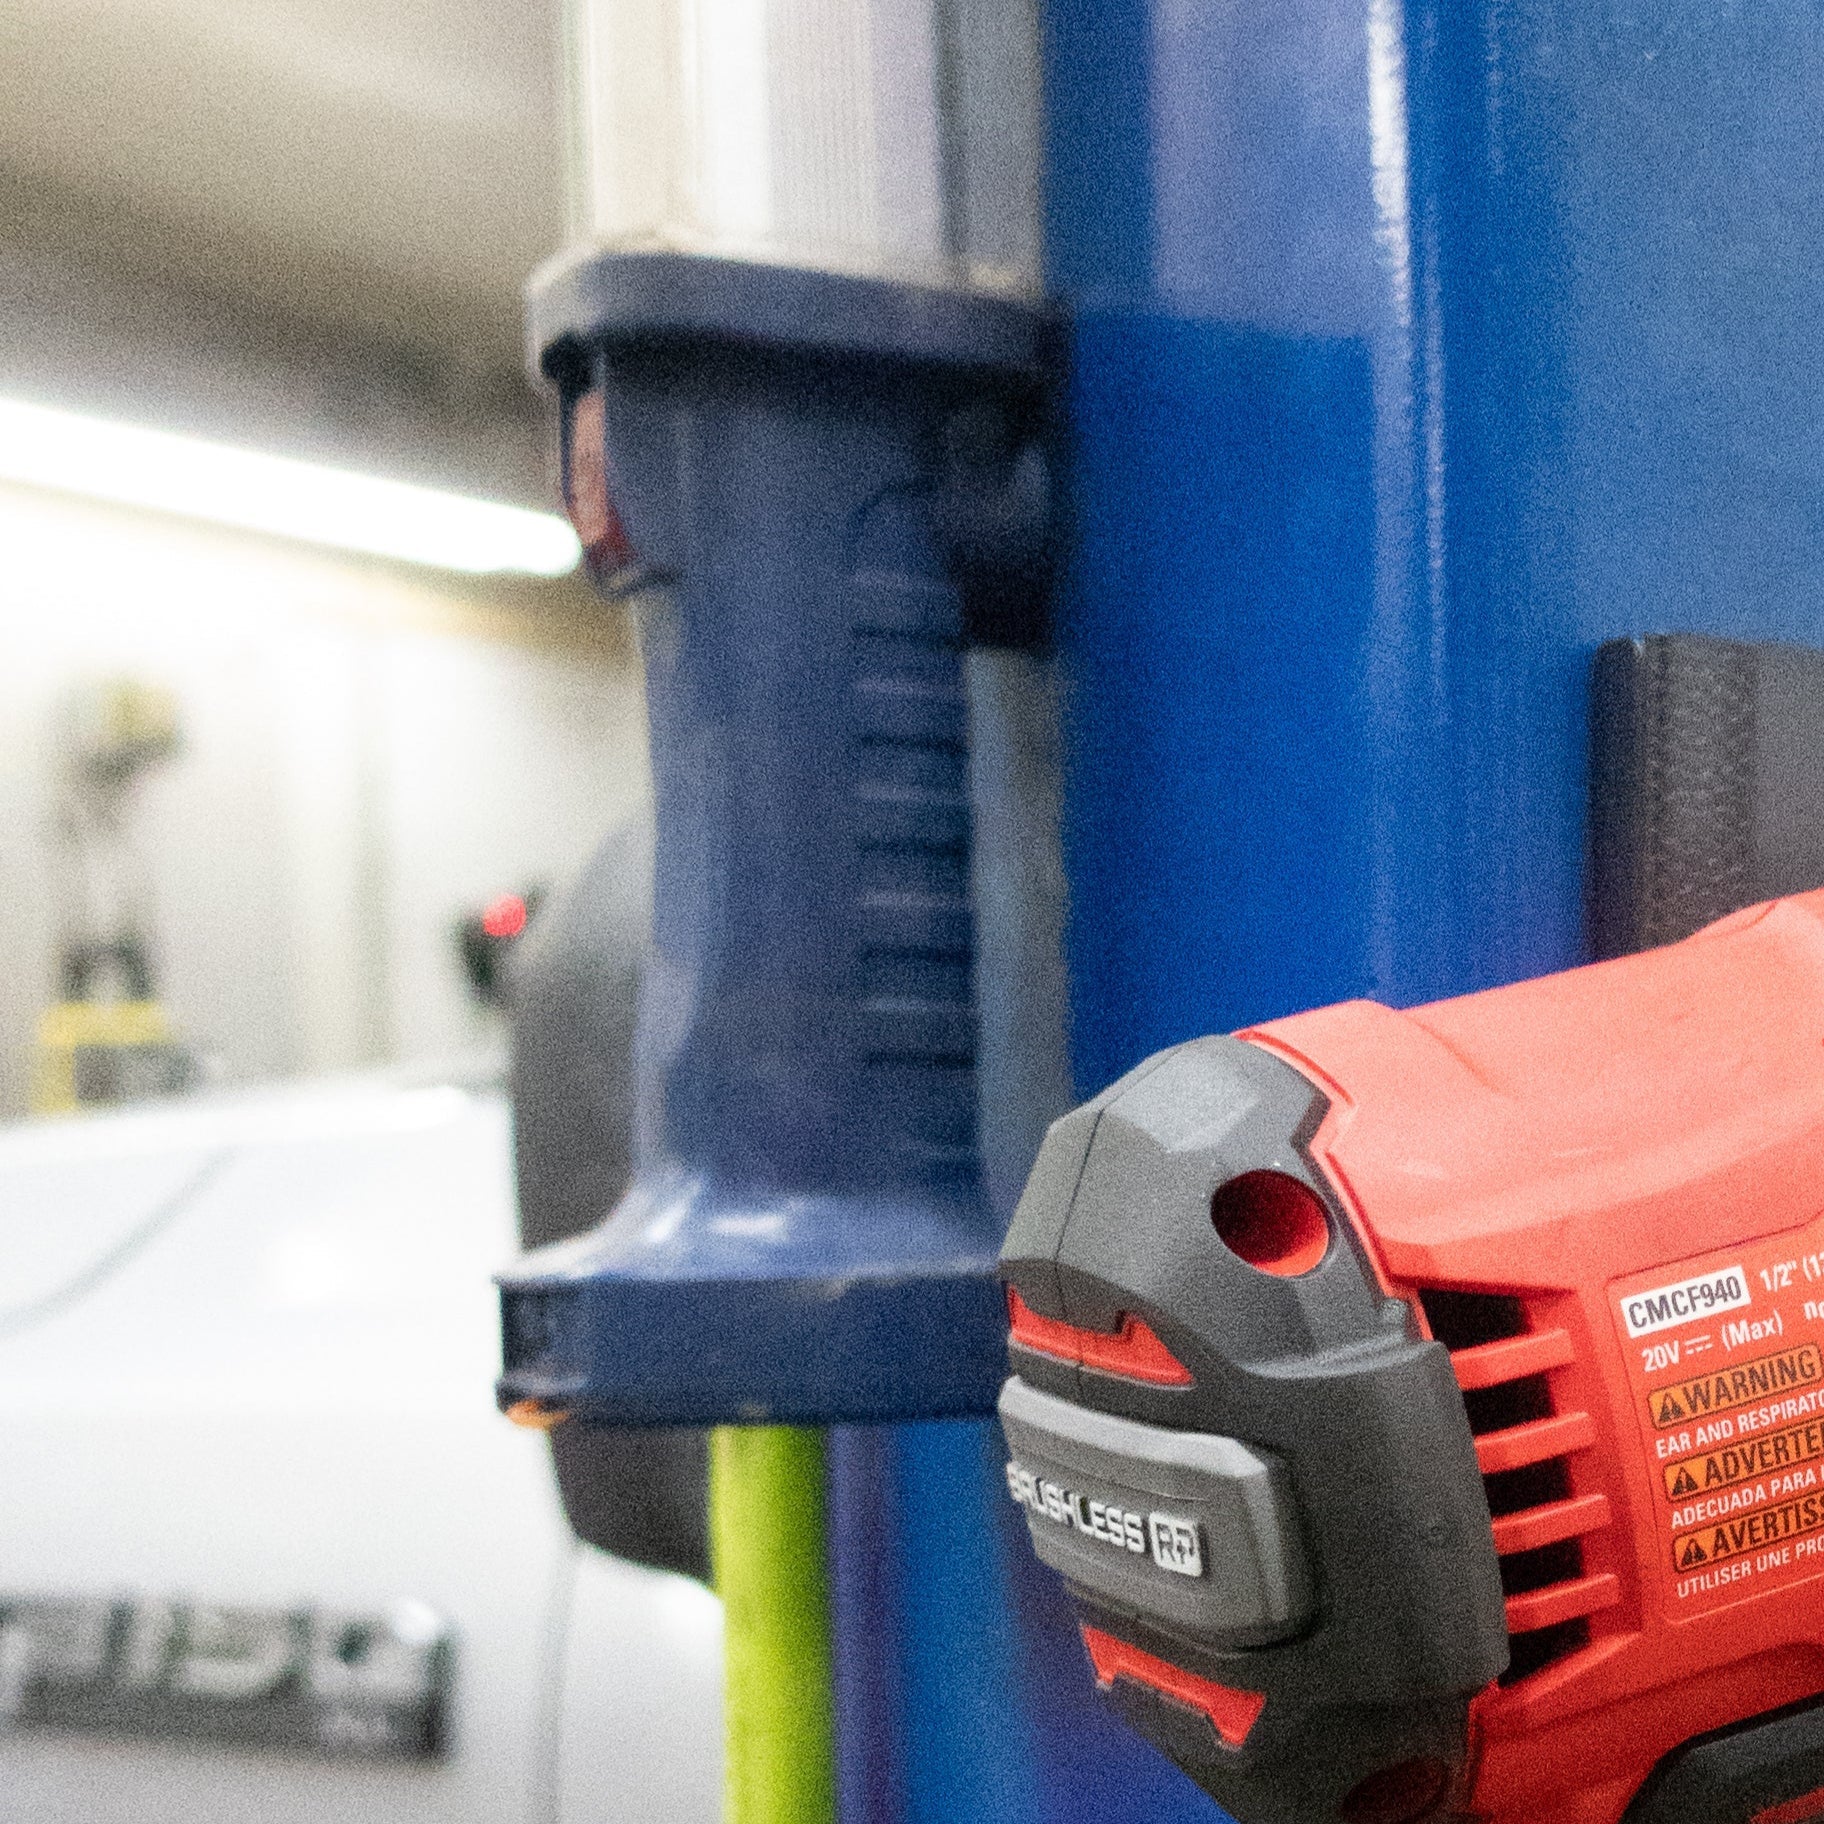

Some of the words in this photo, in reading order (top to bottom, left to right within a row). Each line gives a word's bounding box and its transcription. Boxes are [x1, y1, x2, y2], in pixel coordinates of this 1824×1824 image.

[1759, 1260, 1797, 1291] 1/2"
[1628, 1276, 1741, 1327] CMCF940
[1721, 1309, 1782, 1350] (Max)
[1641, 1340, 1679, 1372] 20V
[1682, 1349, 1815, 1413] WARNING
[1655, 1431, 1691, 1458] EAR
[1695, 1419, 1733, 1446] AND
[1671, 1484, 1766, 1529] ADECUADA
[1770, 1468, 1816, 1496] PARA
[1676, 1559, 1751, 1598] UTILISER
[1756, 1546, 1790, 1572] UNE
